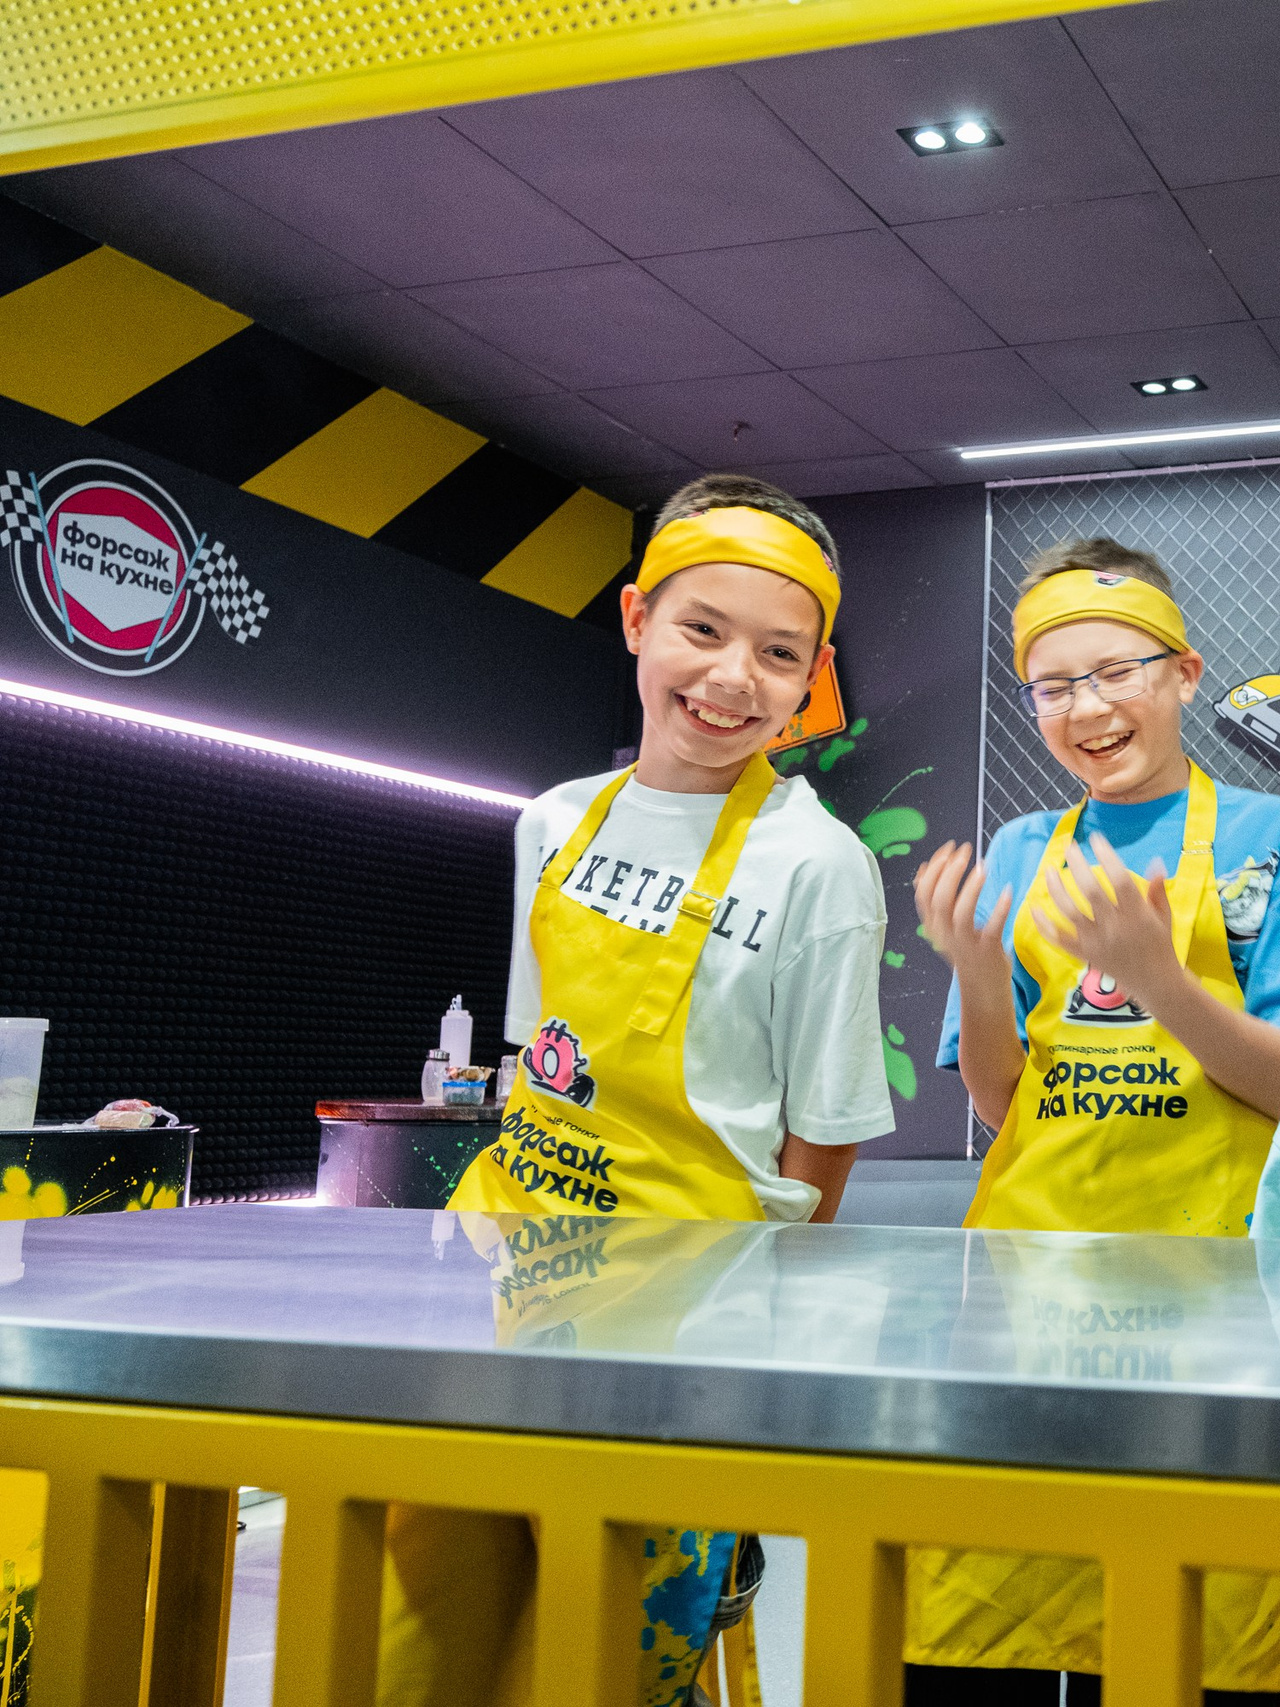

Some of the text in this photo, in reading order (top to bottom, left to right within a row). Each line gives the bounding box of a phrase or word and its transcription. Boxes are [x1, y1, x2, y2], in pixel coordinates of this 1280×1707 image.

[62, 520, 170, 573] форсаж
[60, 547, 174, 595] на кухне
[1121, 1045, 1156, 1054] гонки
[1036, 1091, 1189, 1121] на кухне
[500, 1106, 616, 1183] форсаж
[564, 1121, 600, 1141] гонки
[509, 1154, 619, 1213] кухне
